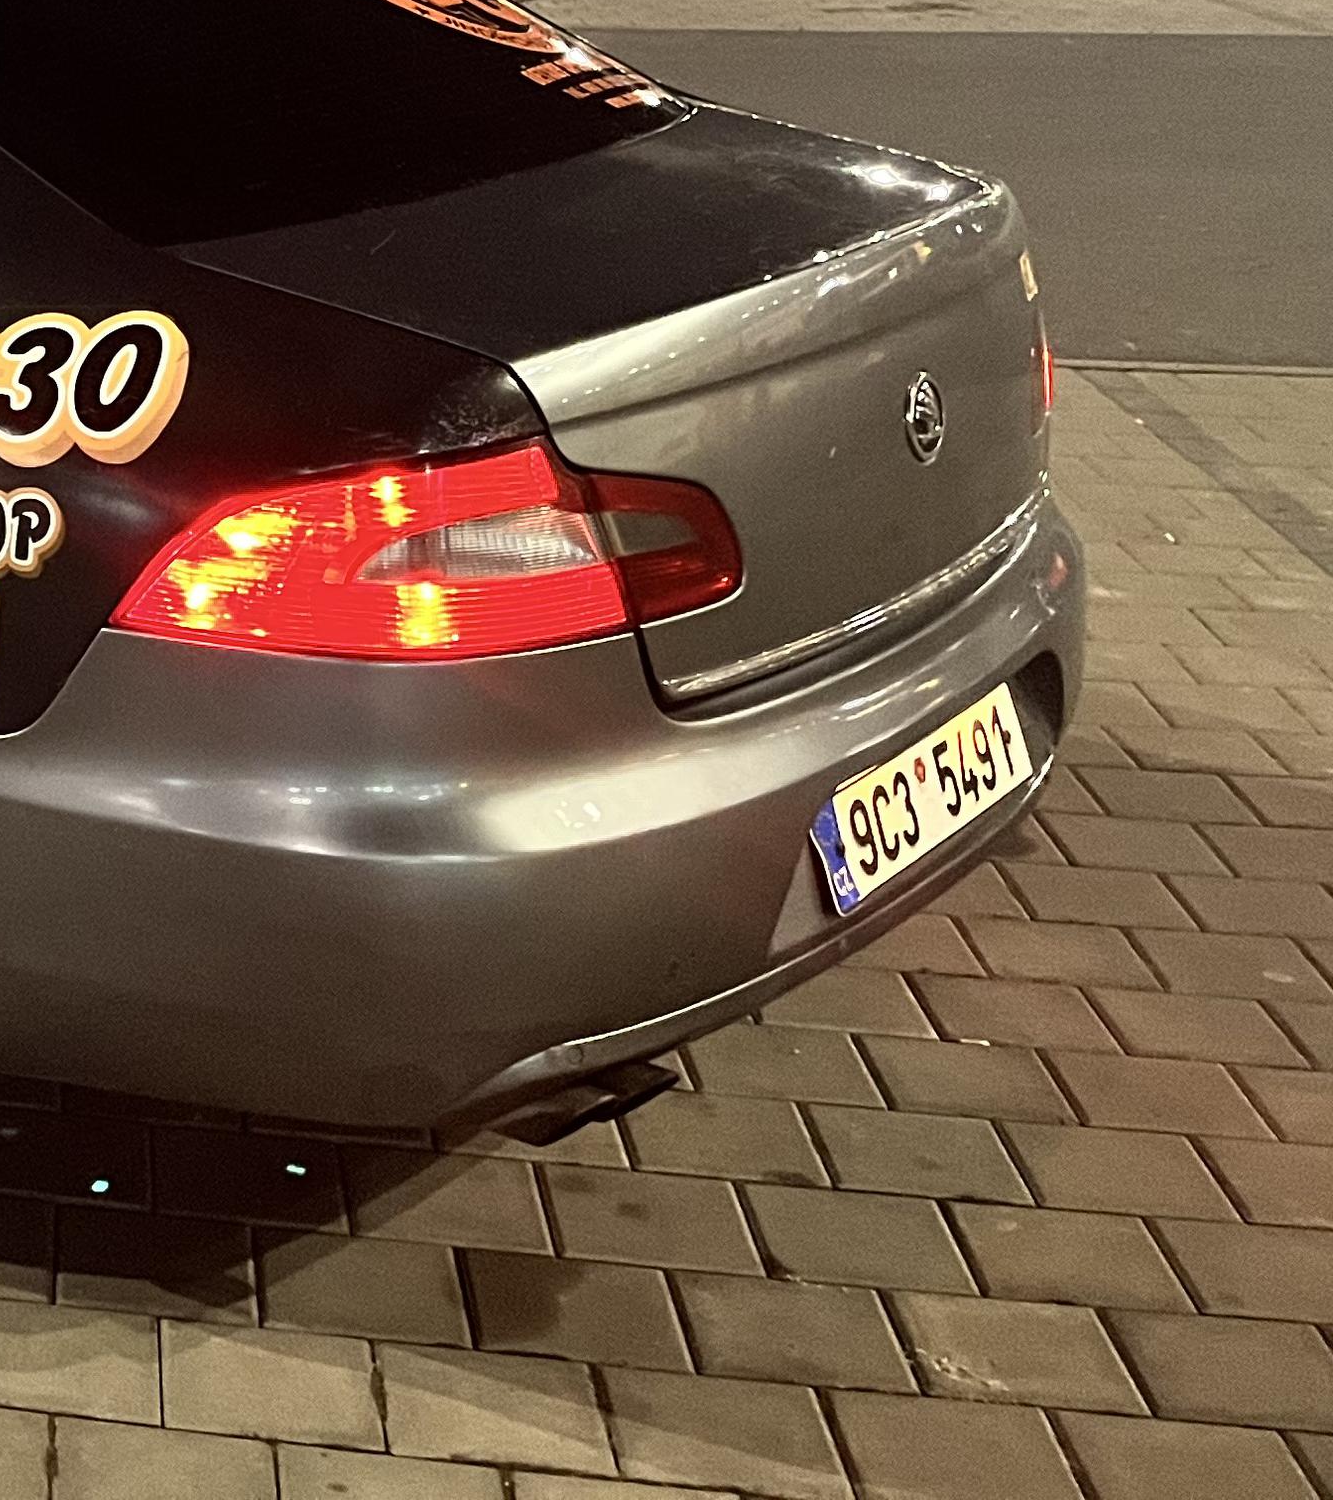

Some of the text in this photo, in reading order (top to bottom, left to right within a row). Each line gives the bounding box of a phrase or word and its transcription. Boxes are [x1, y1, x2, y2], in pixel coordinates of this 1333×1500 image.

[848, 704, 1014, 876] 9C3 5491
[832, 866, 854, 897] CZ
